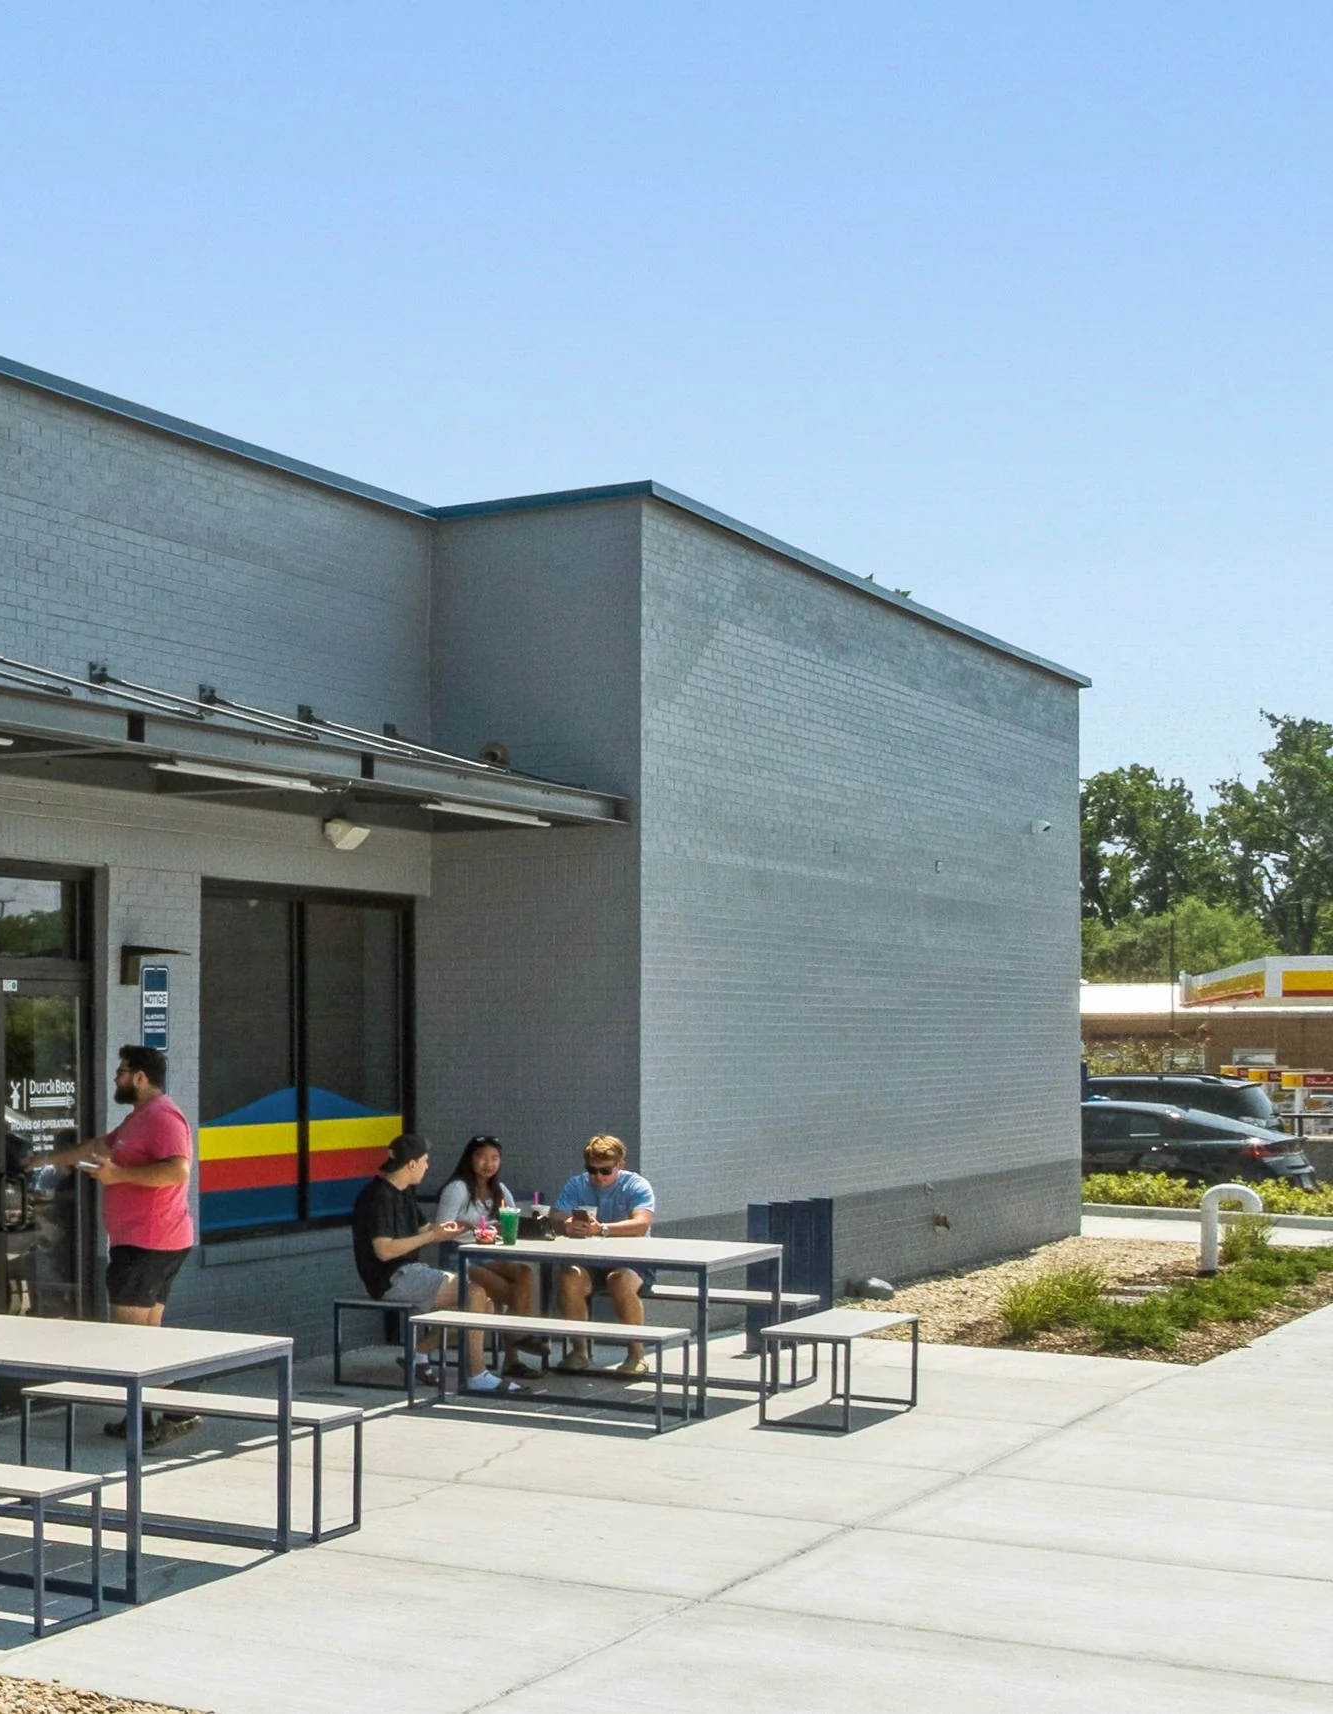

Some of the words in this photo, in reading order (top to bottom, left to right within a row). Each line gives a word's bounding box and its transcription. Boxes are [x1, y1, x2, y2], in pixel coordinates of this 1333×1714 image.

[144, 993, 167, 1005] NOTICE
[11, 1121, 32, 1131] HOURS
[33, 1120, 41, 1130] OF
[42, 1119, 75, 1129] OPERATION
